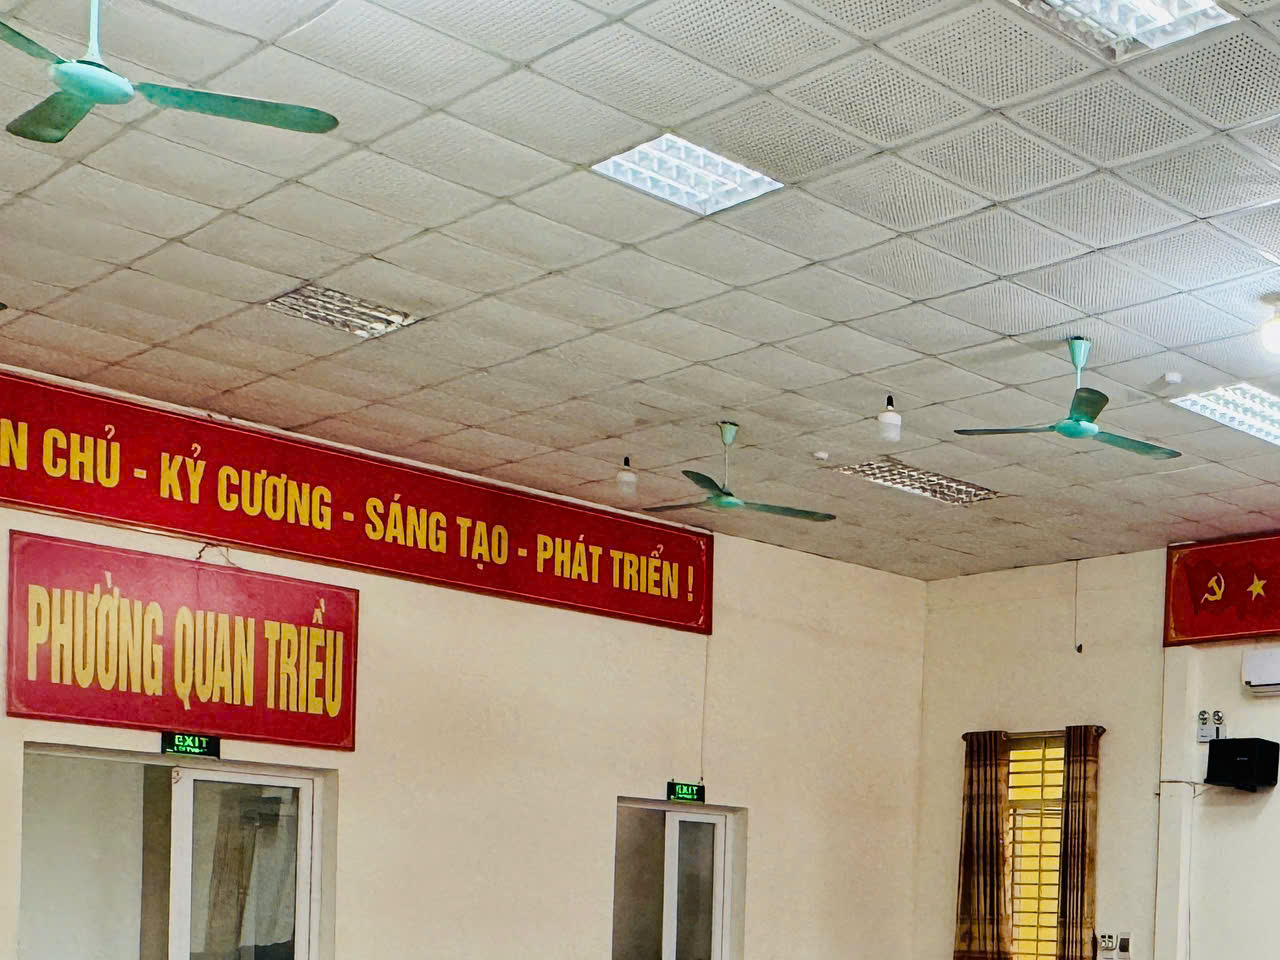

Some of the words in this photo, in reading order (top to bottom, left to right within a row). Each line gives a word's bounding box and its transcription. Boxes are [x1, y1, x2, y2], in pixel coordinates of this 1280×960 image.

[43, 424, 121, 488] CHỦ
[134, 468, 147, 479] -
[160, 443, 207, 504] KỶ
[217, 465, 332, 531] CƯƠNG
[343, 511, 354, 521] -
[365, 493, 447, 553] SÁNG
[456, 516, 509, 570] TẠO
[517, 547, 527, 557] -
[536, 534, 602, 583] PHÁT
[610, 544, 679, 599] TRIỂN
[687, 565, 694, 602] !
[27, 570, 164, 697] PHƯỜNG
[174, 605, 256, 711] QUAN
[263, 597, 344, 718] TRIỀU
[174, 735, 209, 747] EXIT
[676, 785, 698, 794] EXIT
